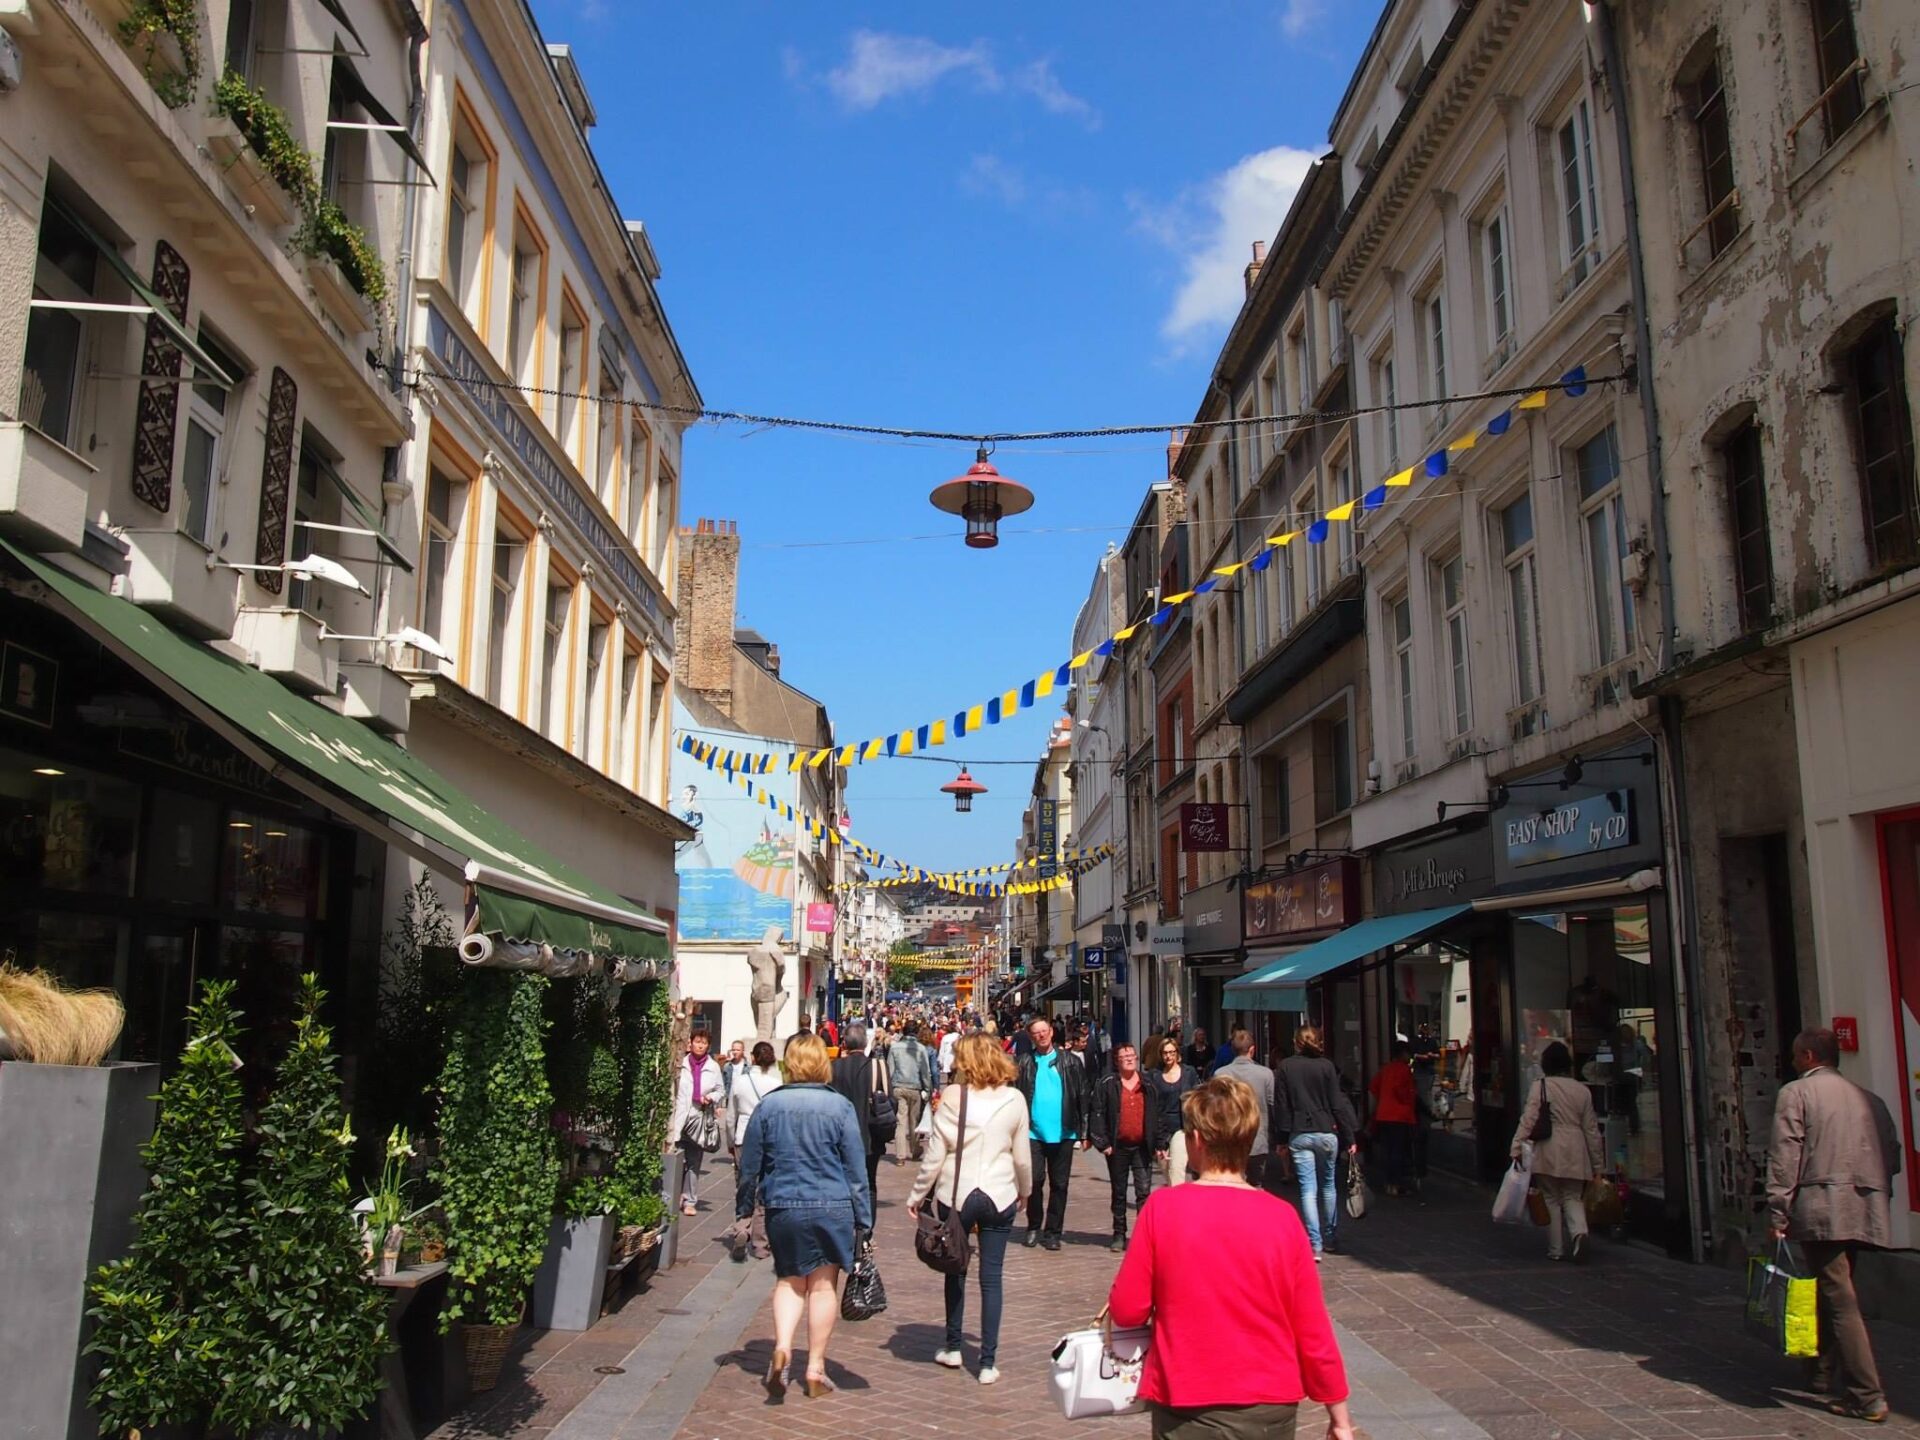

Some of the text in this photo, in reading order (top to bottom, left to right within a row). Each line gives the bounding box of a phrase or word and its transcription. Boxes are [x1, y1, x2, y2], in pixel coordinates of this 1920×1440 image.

[504, 408, 521, 448] DE
[1042, 803, 1054, 854] BUS STO
[1507, 807, 1580, 846] EASY SHOP
[1589, 815, 1627, 849] by CD
[1401, 857, 1465, 899] Jeff de Bruges
